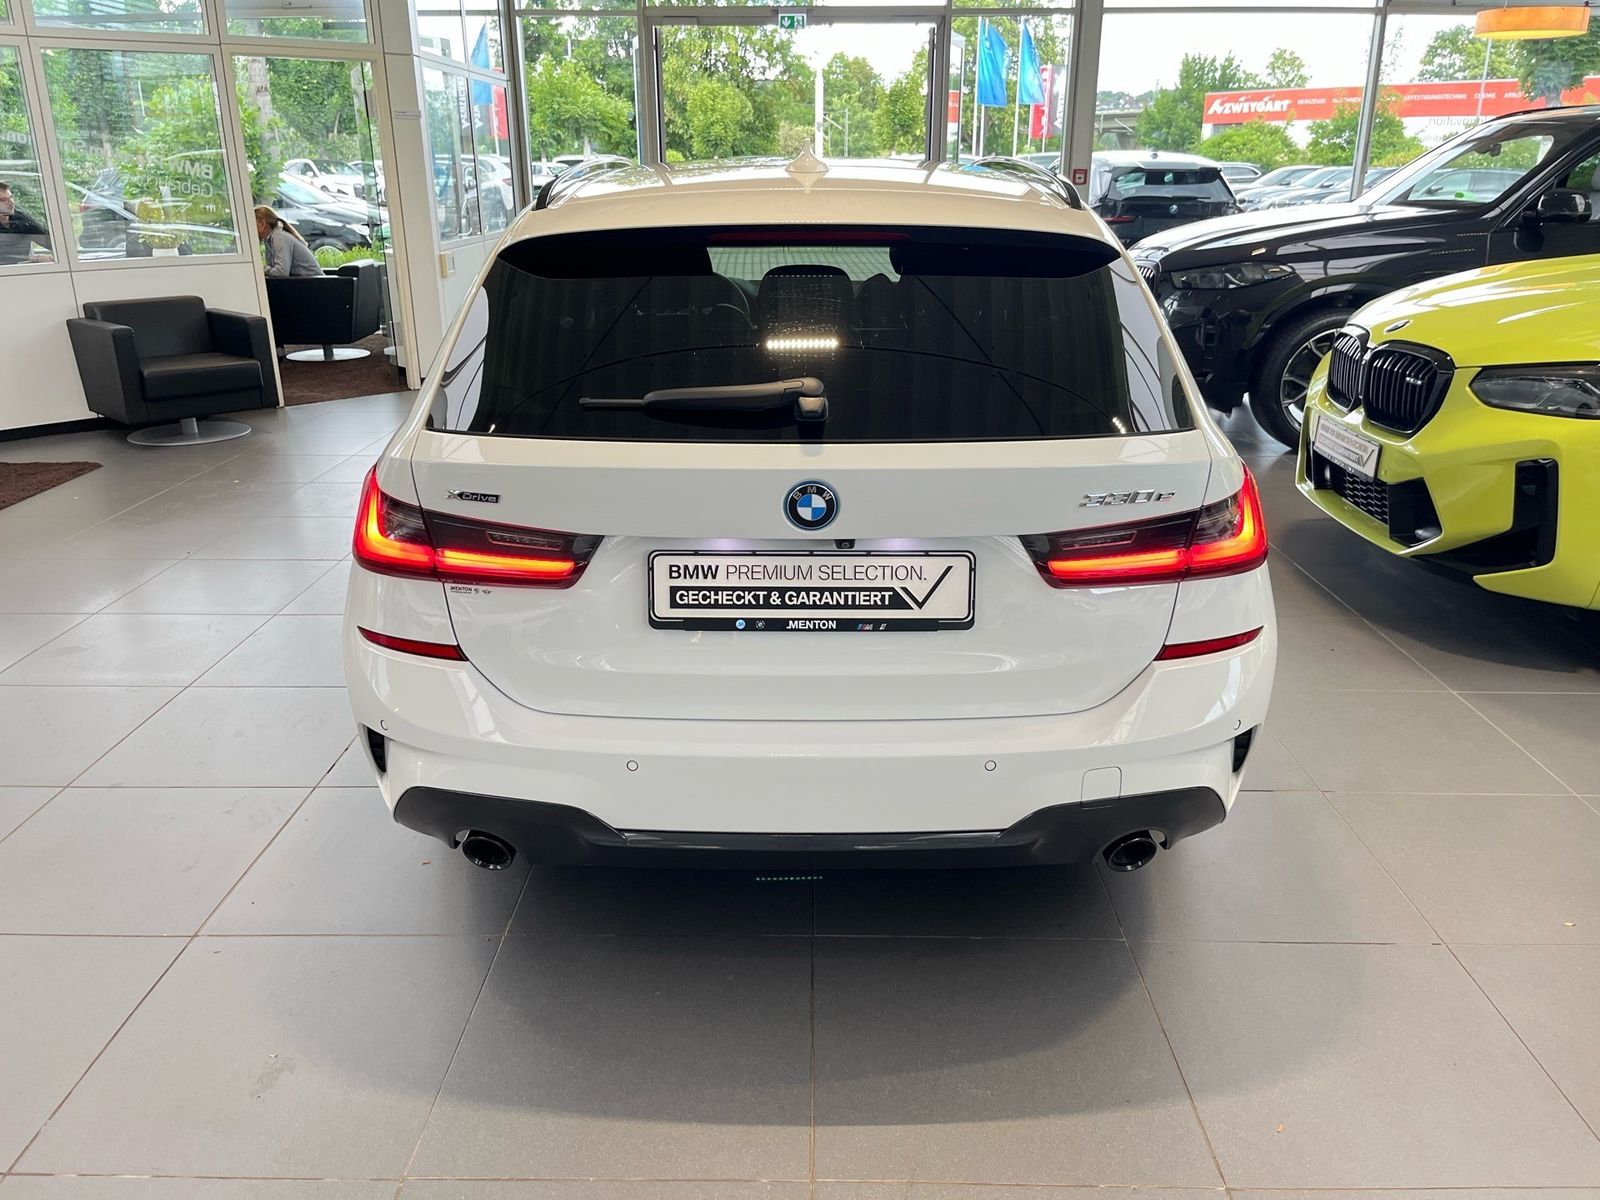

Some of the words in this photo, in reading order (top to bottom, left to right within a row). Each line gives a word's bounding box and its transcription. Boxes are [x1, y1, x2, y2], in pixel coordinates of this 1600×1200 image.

[792, 486, 833, 501] BMW
[668, 564, 719, 580] BMW
[726, 564, 813, 580] PREMIUM
[818, 564, 927, 581] SELECTION.
[675, 590, 767, 605] GECHECKT
[769, 592, 782, 605] &
[784, 591, 893, 606] GARANTIERT
[787, 620, 837, 630] MENTON
